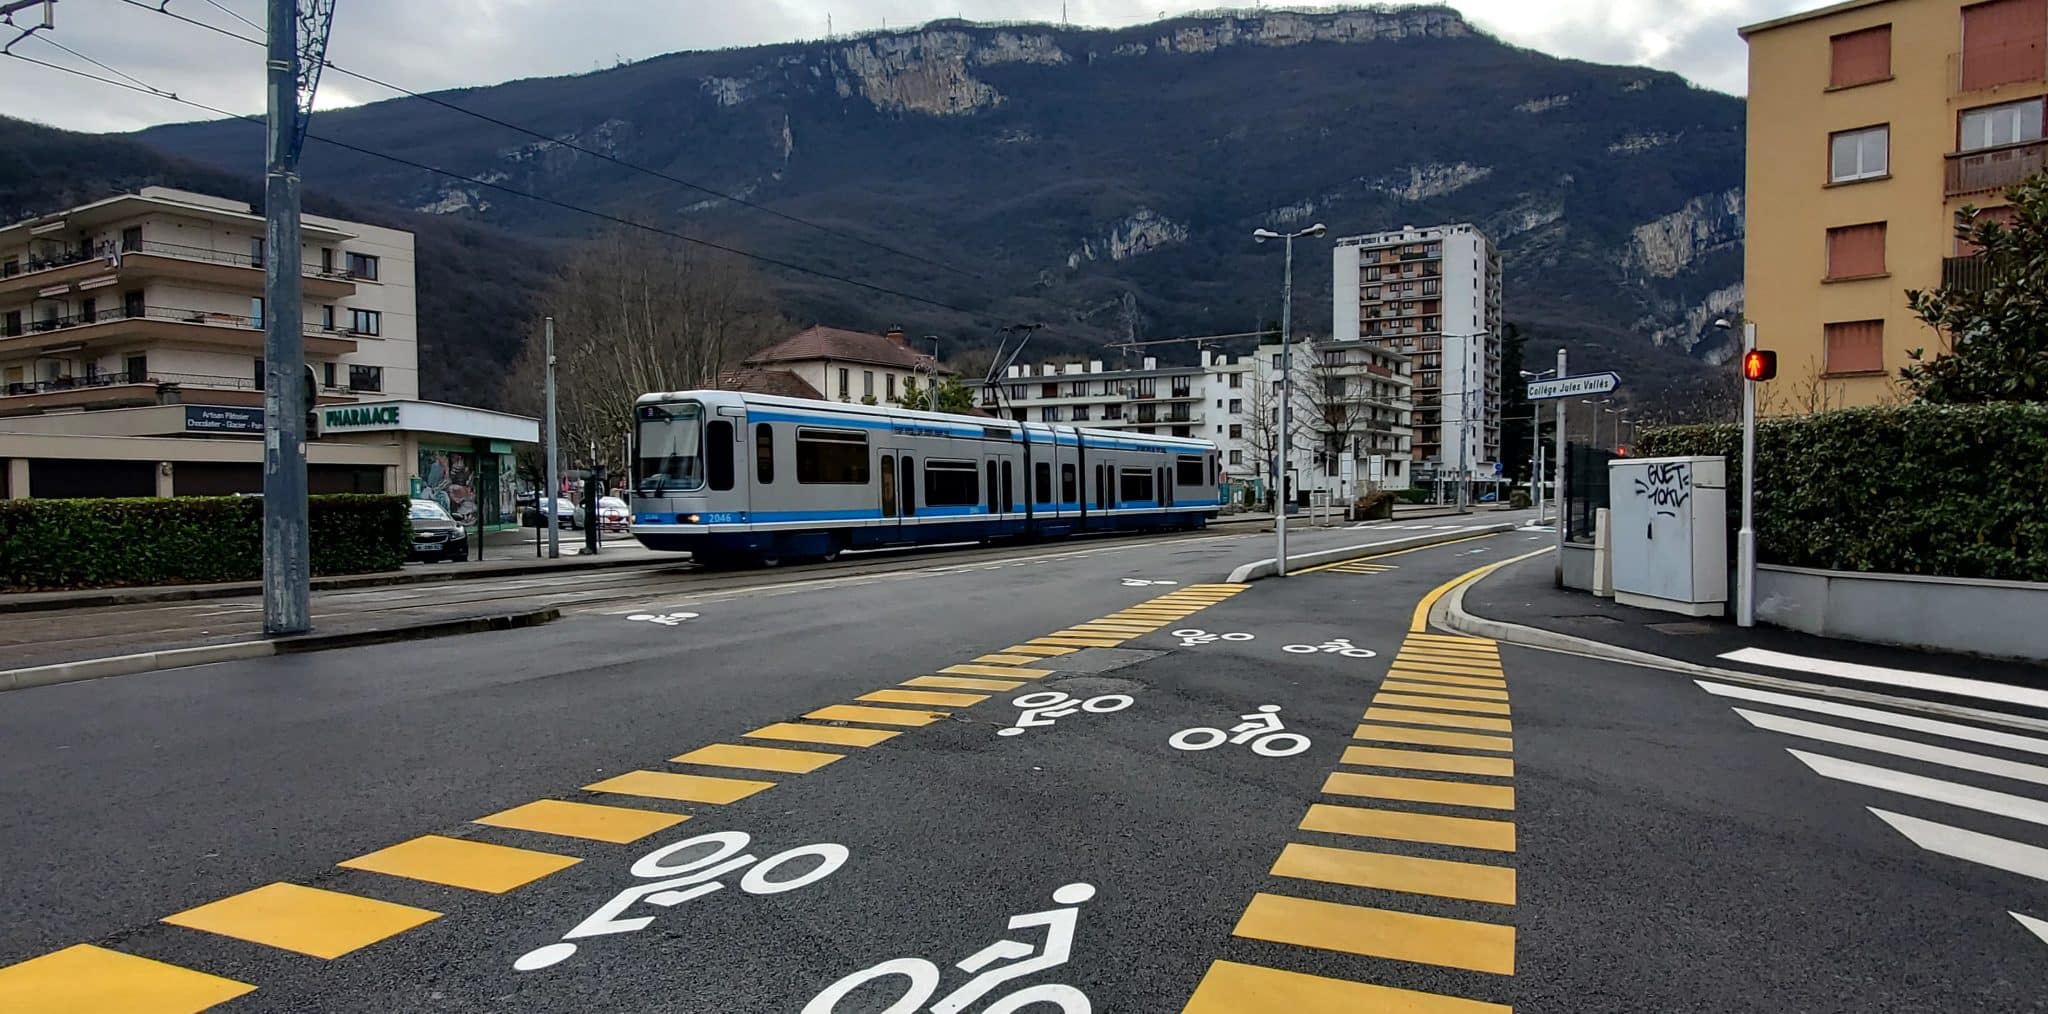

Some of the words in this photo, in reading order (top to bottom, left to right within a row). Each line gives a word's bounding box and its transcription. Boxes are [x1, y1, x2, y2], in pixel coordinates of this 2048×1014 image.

[1560, 383, 1580, 393] Jules
[325, 406, 400, 427] PHARMACIE
[708, 513, 732, 523] 2046
